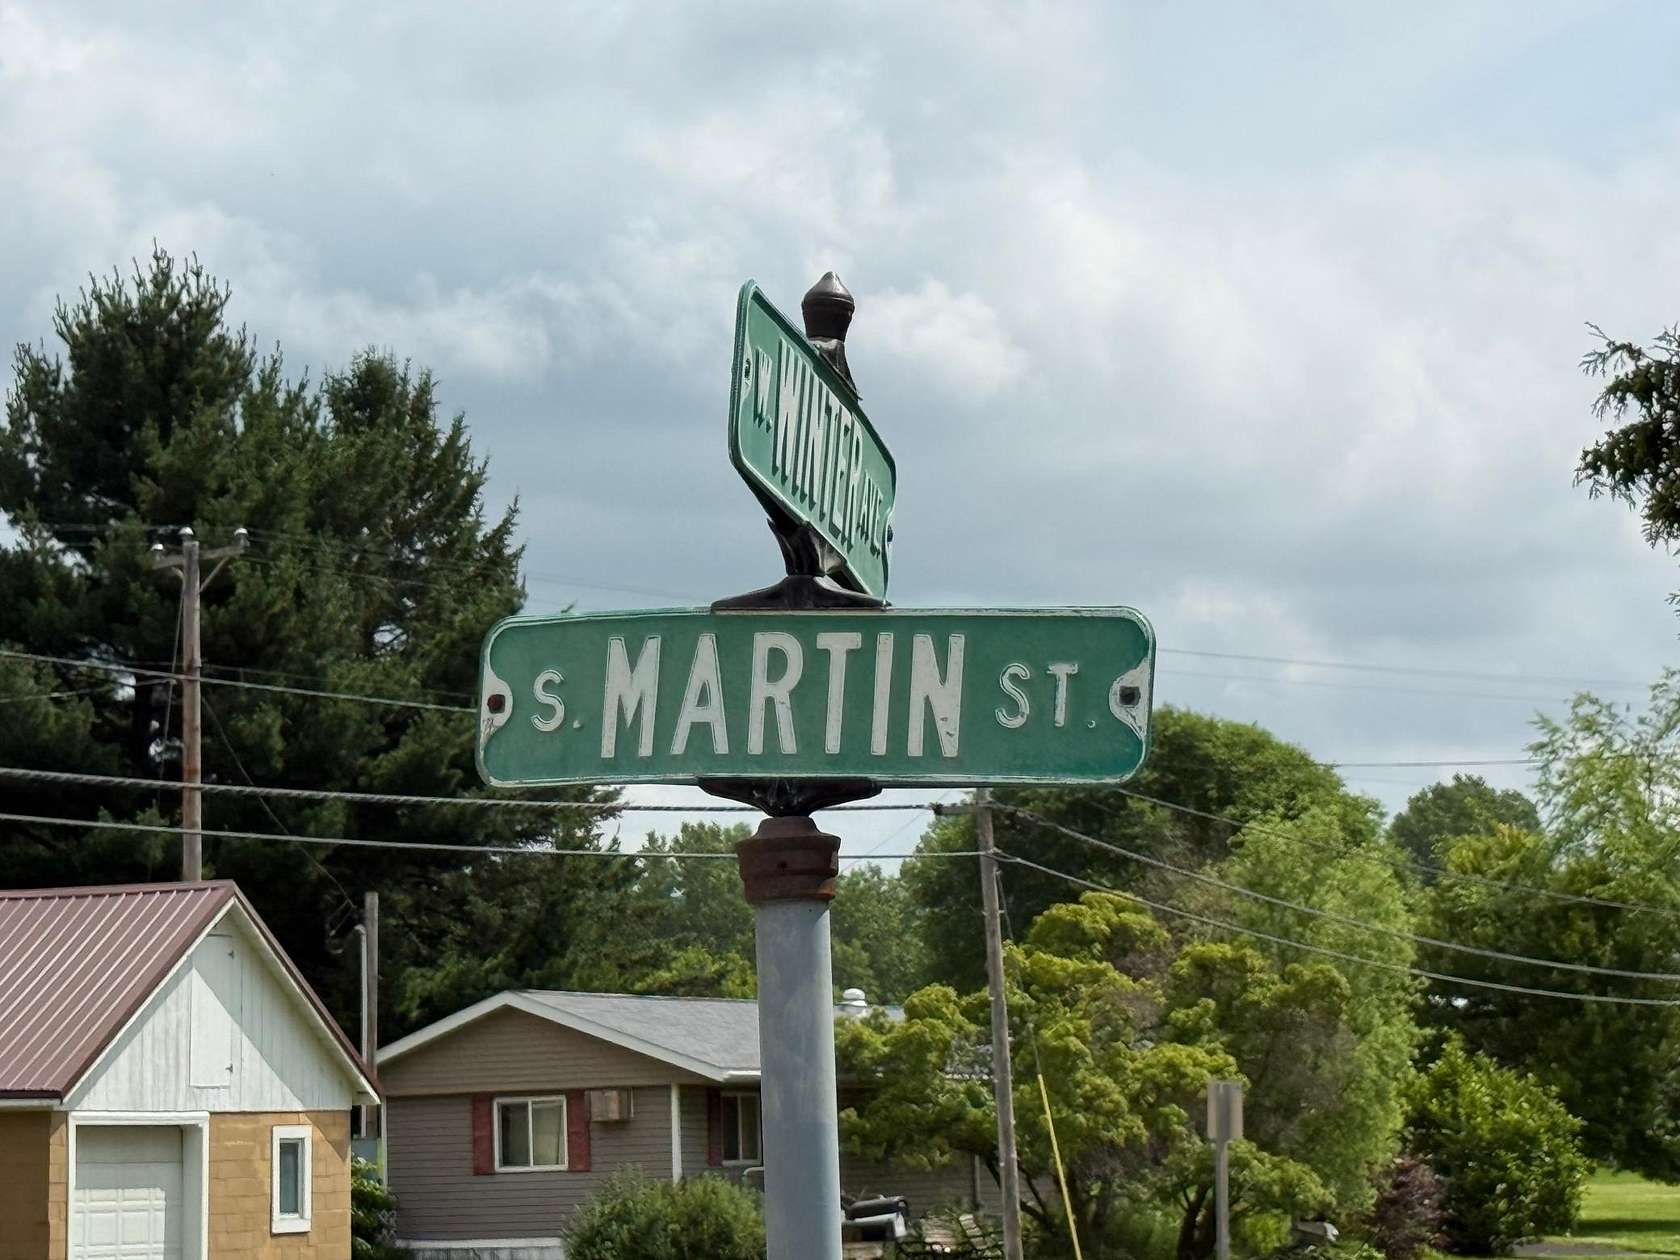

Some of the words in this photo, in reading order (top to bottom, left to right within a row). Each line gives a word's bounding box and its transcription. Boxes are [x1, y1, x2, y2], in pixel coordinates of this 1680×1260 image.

[773, 337, 864, 552] WINTER
[530, 669, 581, 732] S.
[601, 632, 966, 758] MARTIN
[995, 662, 1096, 728] ST.
